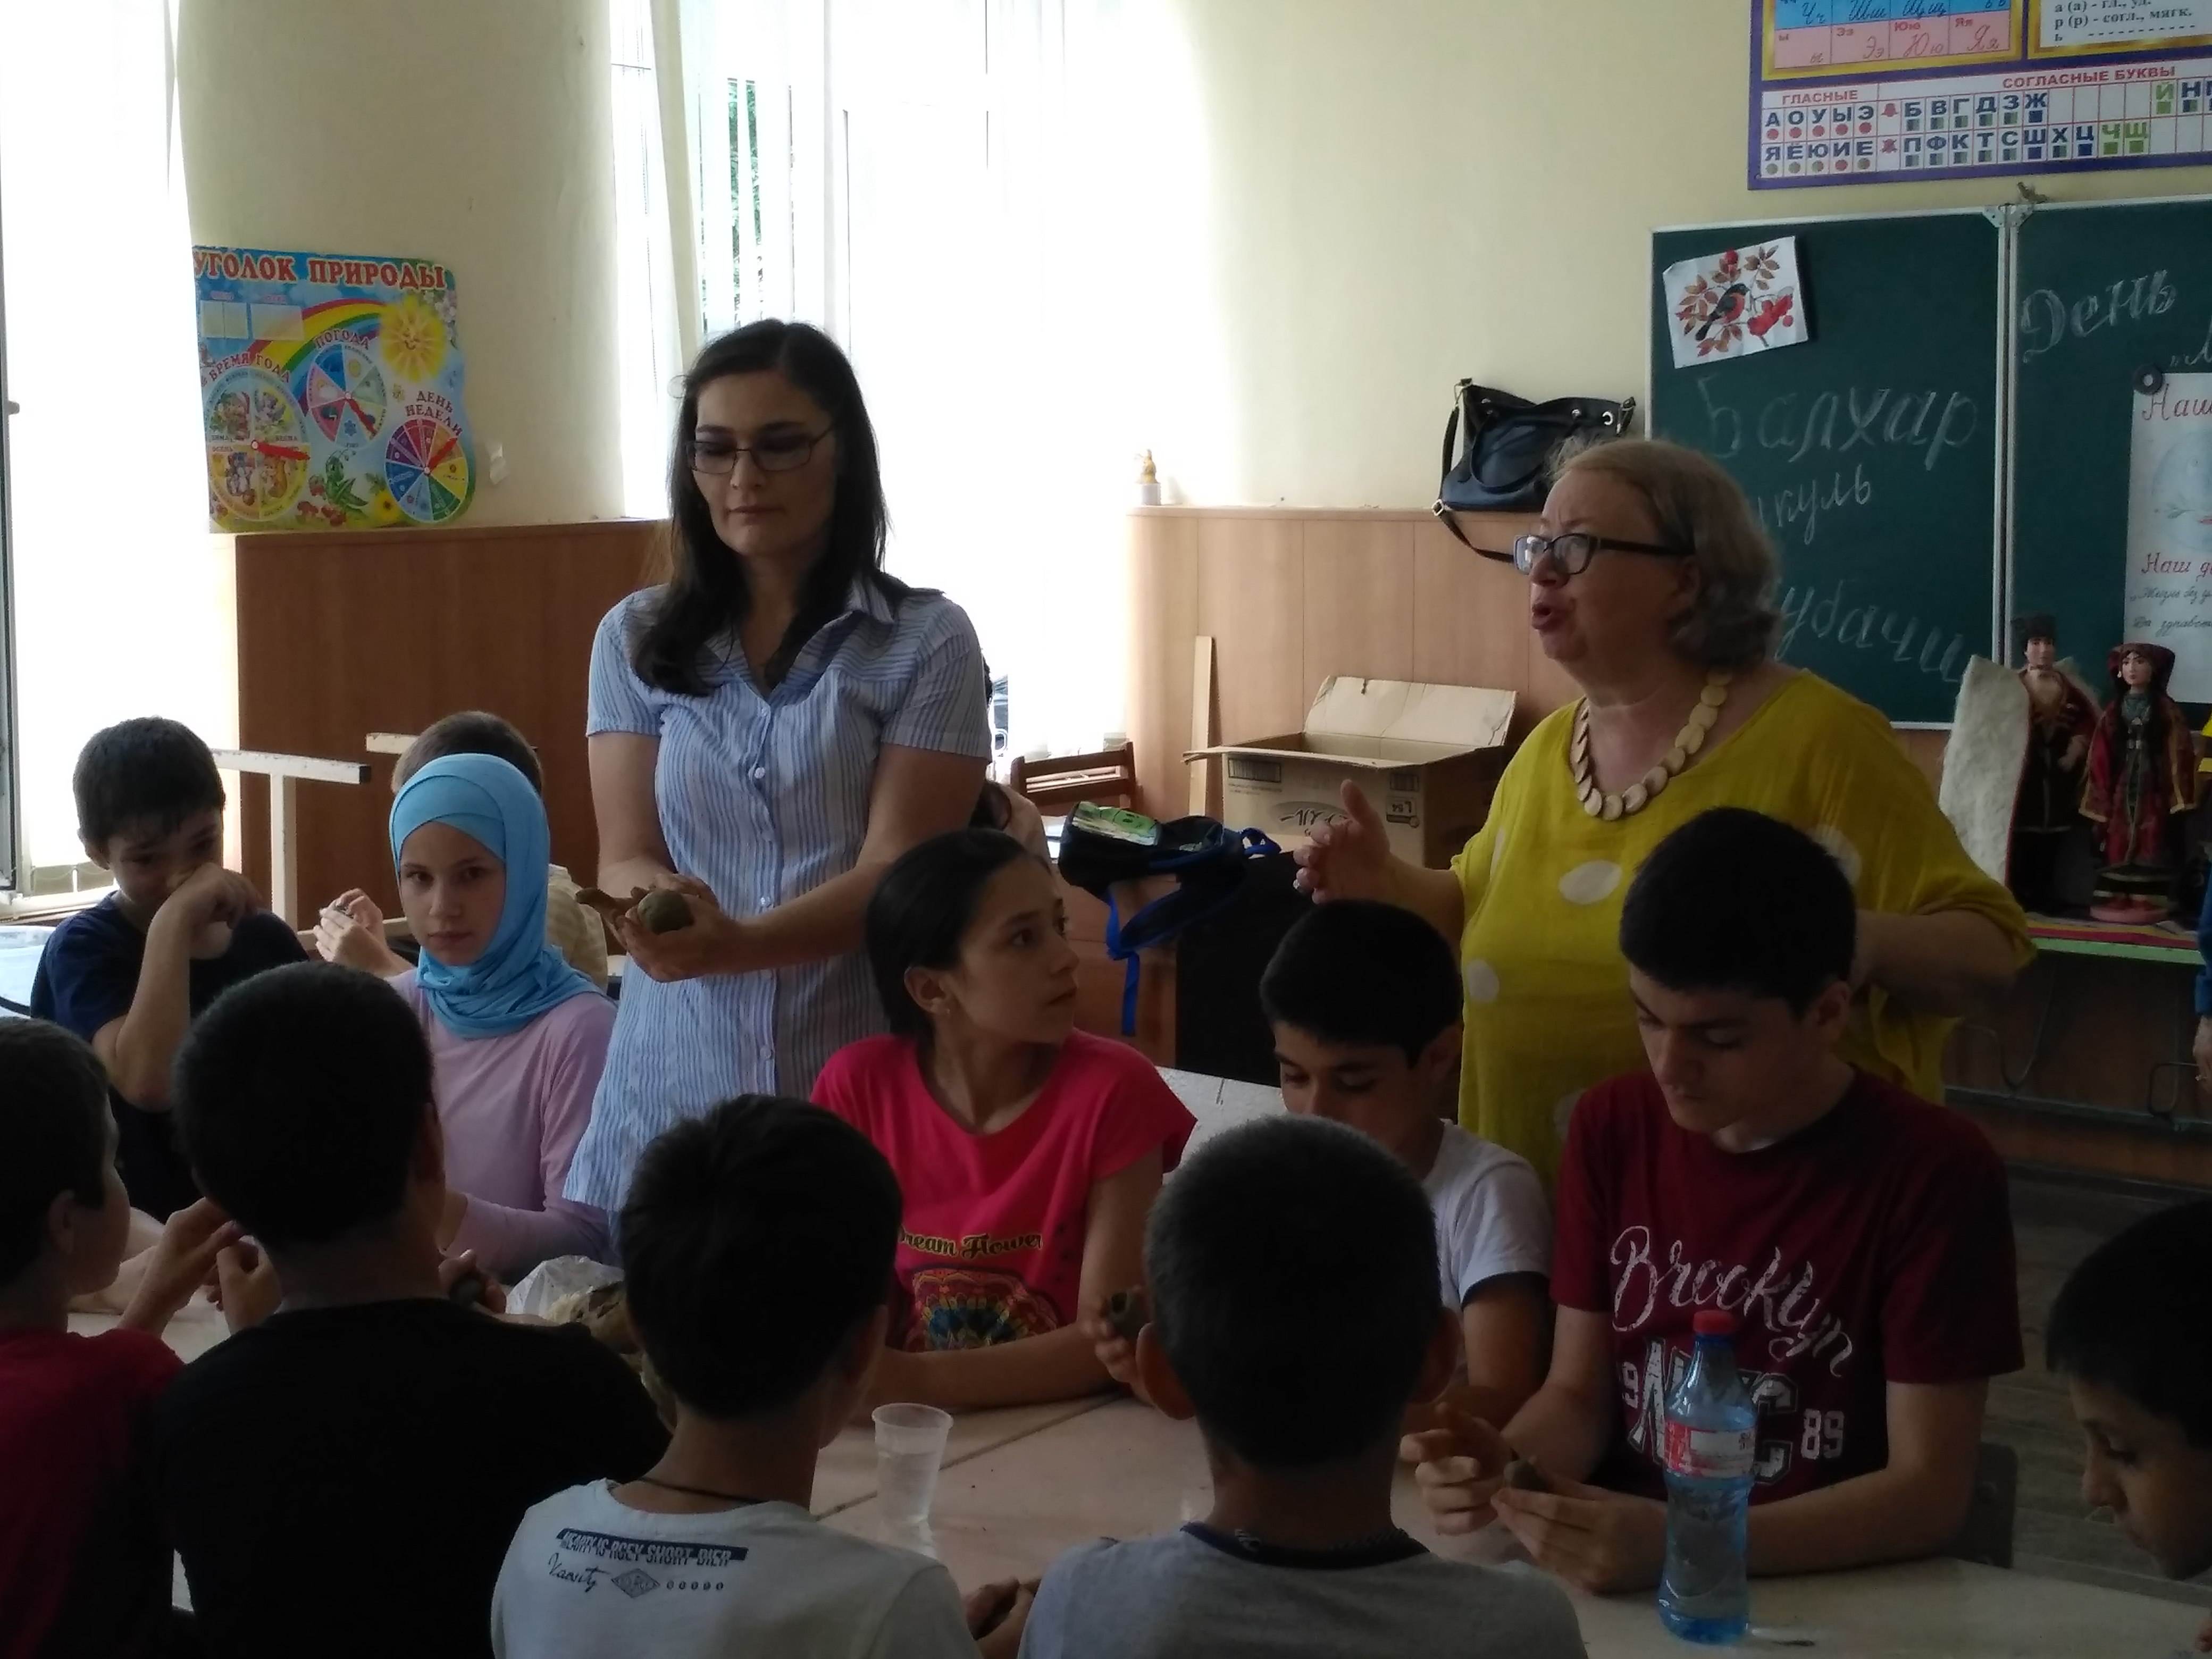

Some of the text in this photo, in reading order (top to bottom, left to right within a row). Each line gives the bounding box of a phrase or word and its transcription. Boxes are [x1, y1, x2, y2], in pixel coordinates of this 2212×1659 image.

[2002, 66, 2175, 89] СОГЛАСНЫЕ БУКВЫ
[1783, 90, 1858, 105] ГЛАСНЫЕ
[308, 260, 446, 290] ПРИРОДЫ
[2021, 269, 2176, 363] День
[314, 328, 371, 350] ПОГОДА
[209, 351, 290, 383] ВРЕМЯ ГОДА
[416, 390, 454, 413] ДЕНЬ
[405, 405, 463, 436] НЕДЕЛИ
[1697, 374, 1978, 472] Балхар
[1758, 464, 1871, 545] куль
[2141, 552, 2191, 574] Наш
[1773, 579, 1964, 682] убачи
[1610, 1225, 1853, 1379] Brooklyn
[1799, 1407, 1846, 1461] 89
